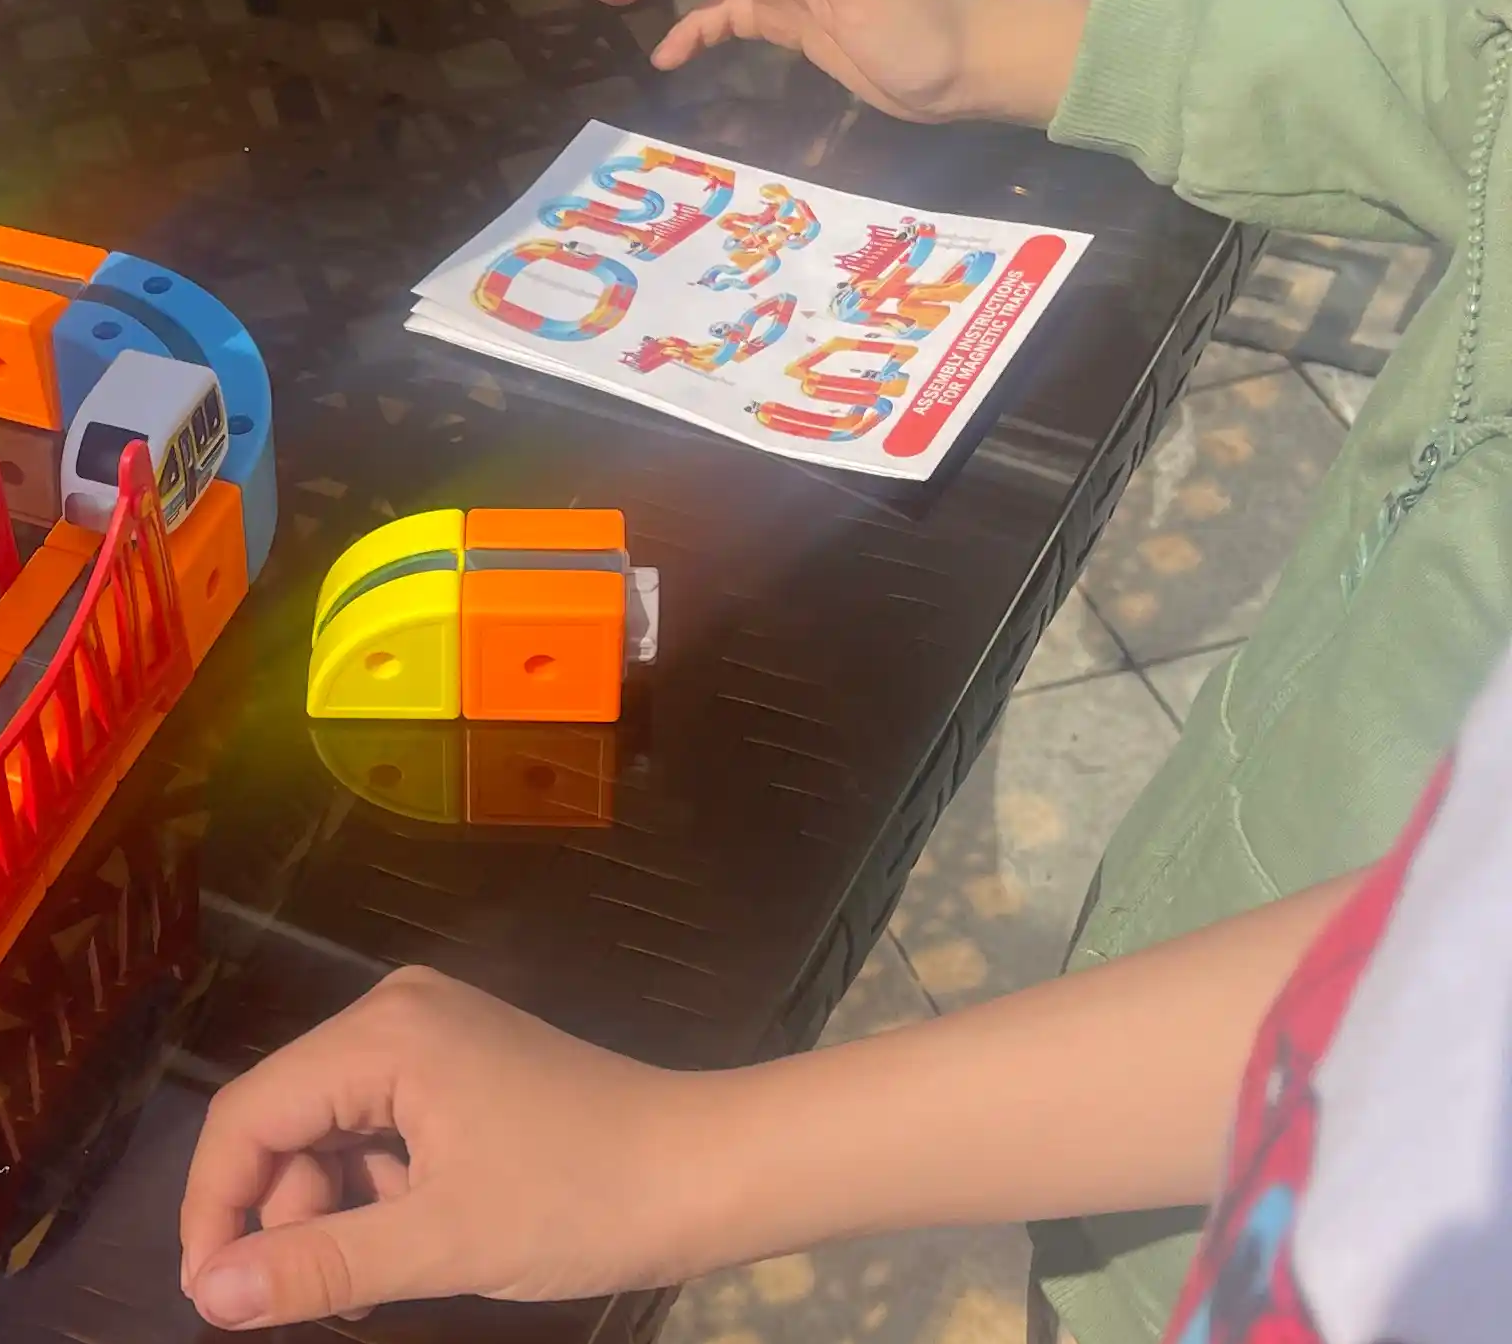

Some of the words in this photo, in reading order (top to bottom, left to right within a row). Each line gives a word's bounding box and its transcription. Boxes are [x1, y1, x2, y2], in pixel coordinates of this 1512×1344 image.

[913, 352, 965, 416] ASSEMBLY
[956, 269, 1024, 351] INSTRUCTIONS
[937, 381, 966, 406] FOR
[956, 319, 1008, 380] MAGNETIC
[999, 281, 1037, 317] TRACK
